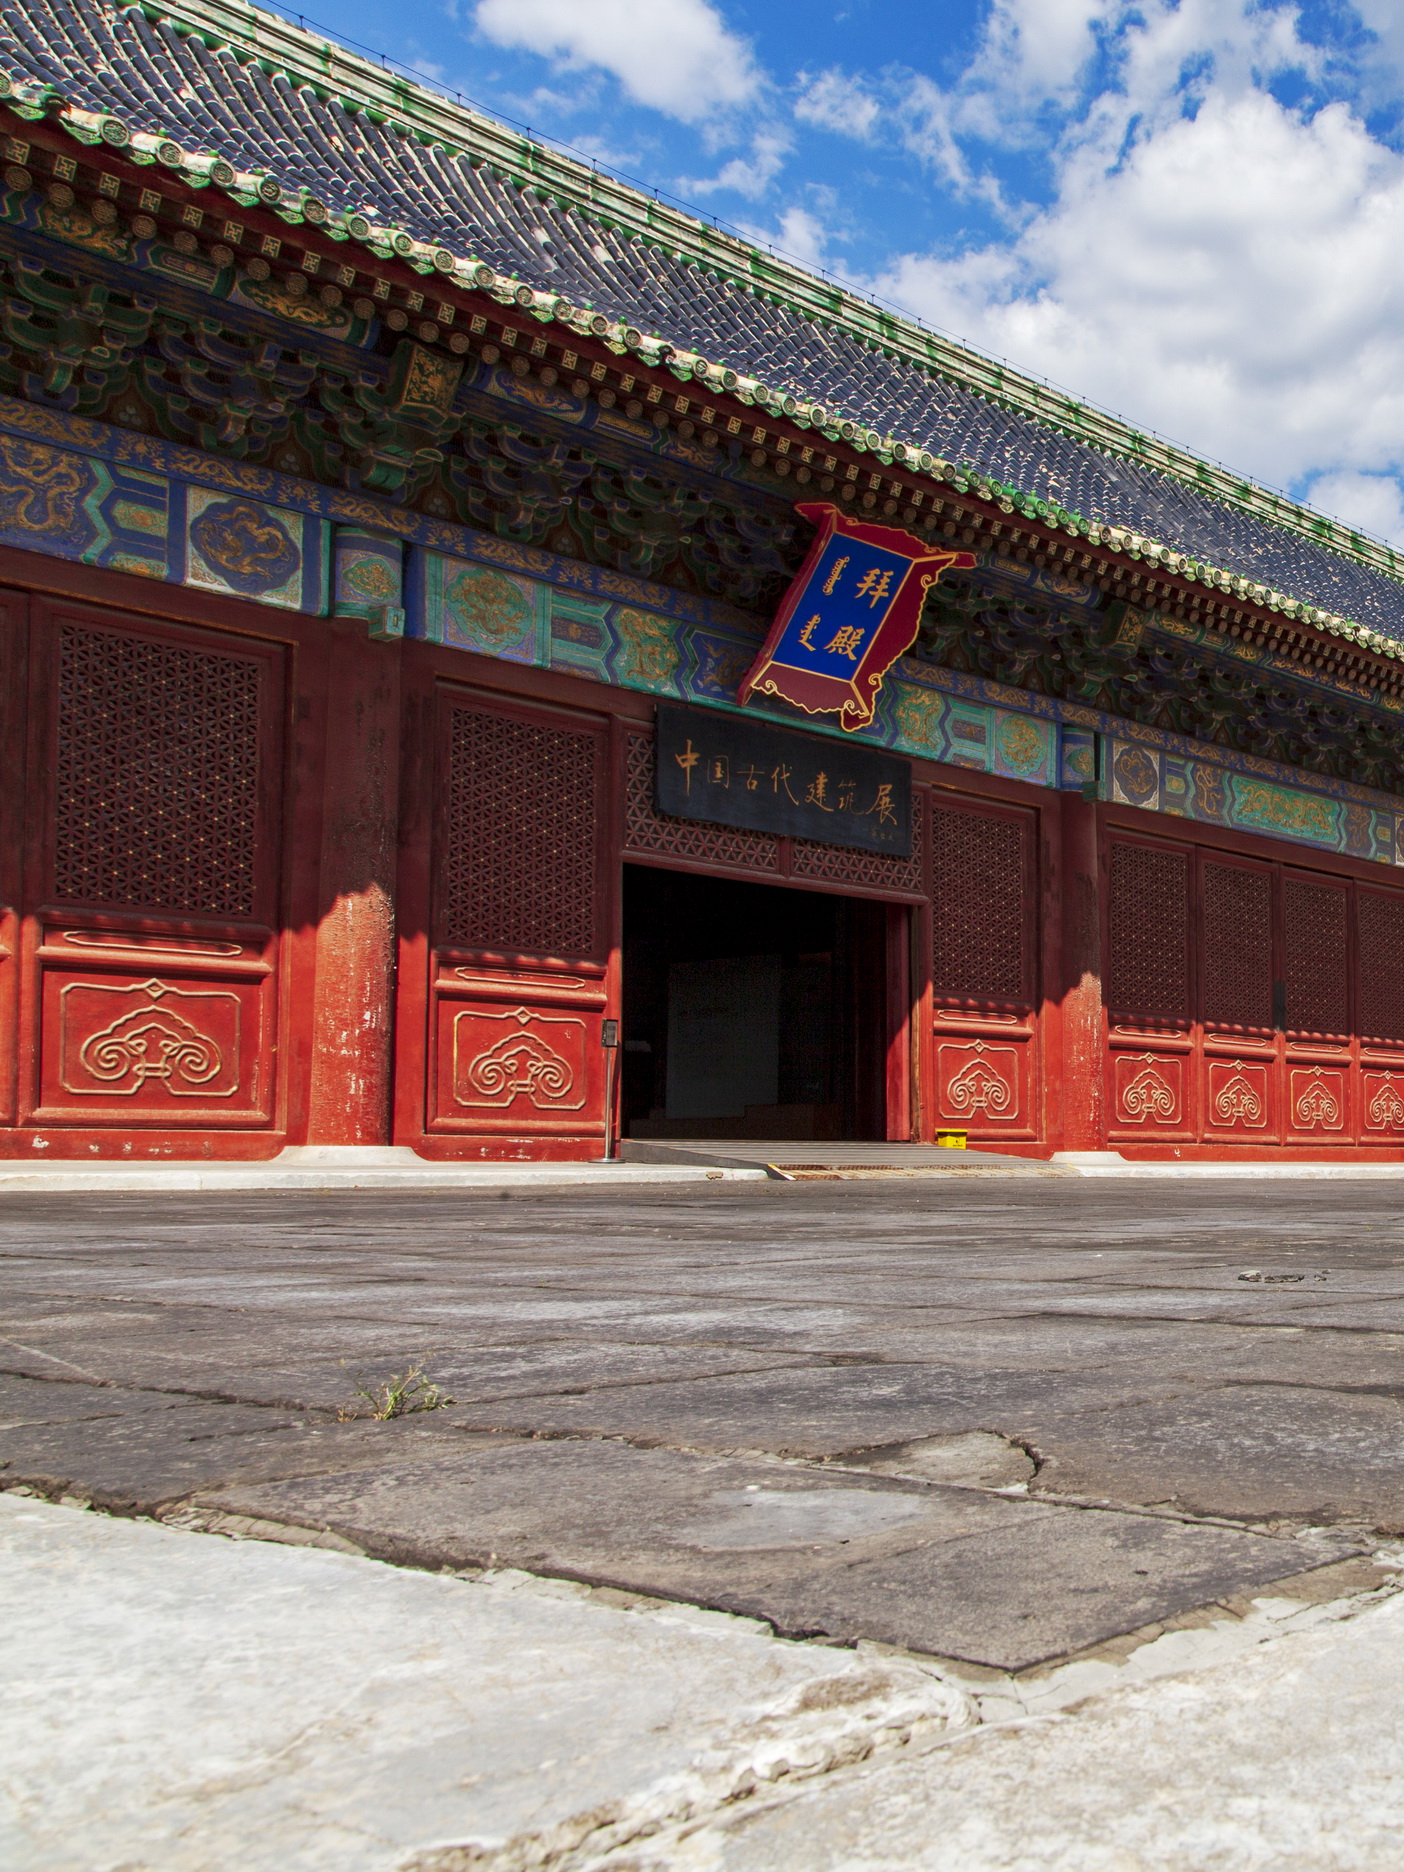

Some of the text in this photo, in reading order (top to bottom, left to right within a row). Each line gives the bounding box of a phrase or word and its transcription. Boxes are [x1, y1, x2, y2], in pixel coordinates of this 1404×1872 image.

[823, 568, 895, 661] 拜殿
[674, 738, 898, 826] 中国古代建筑展
